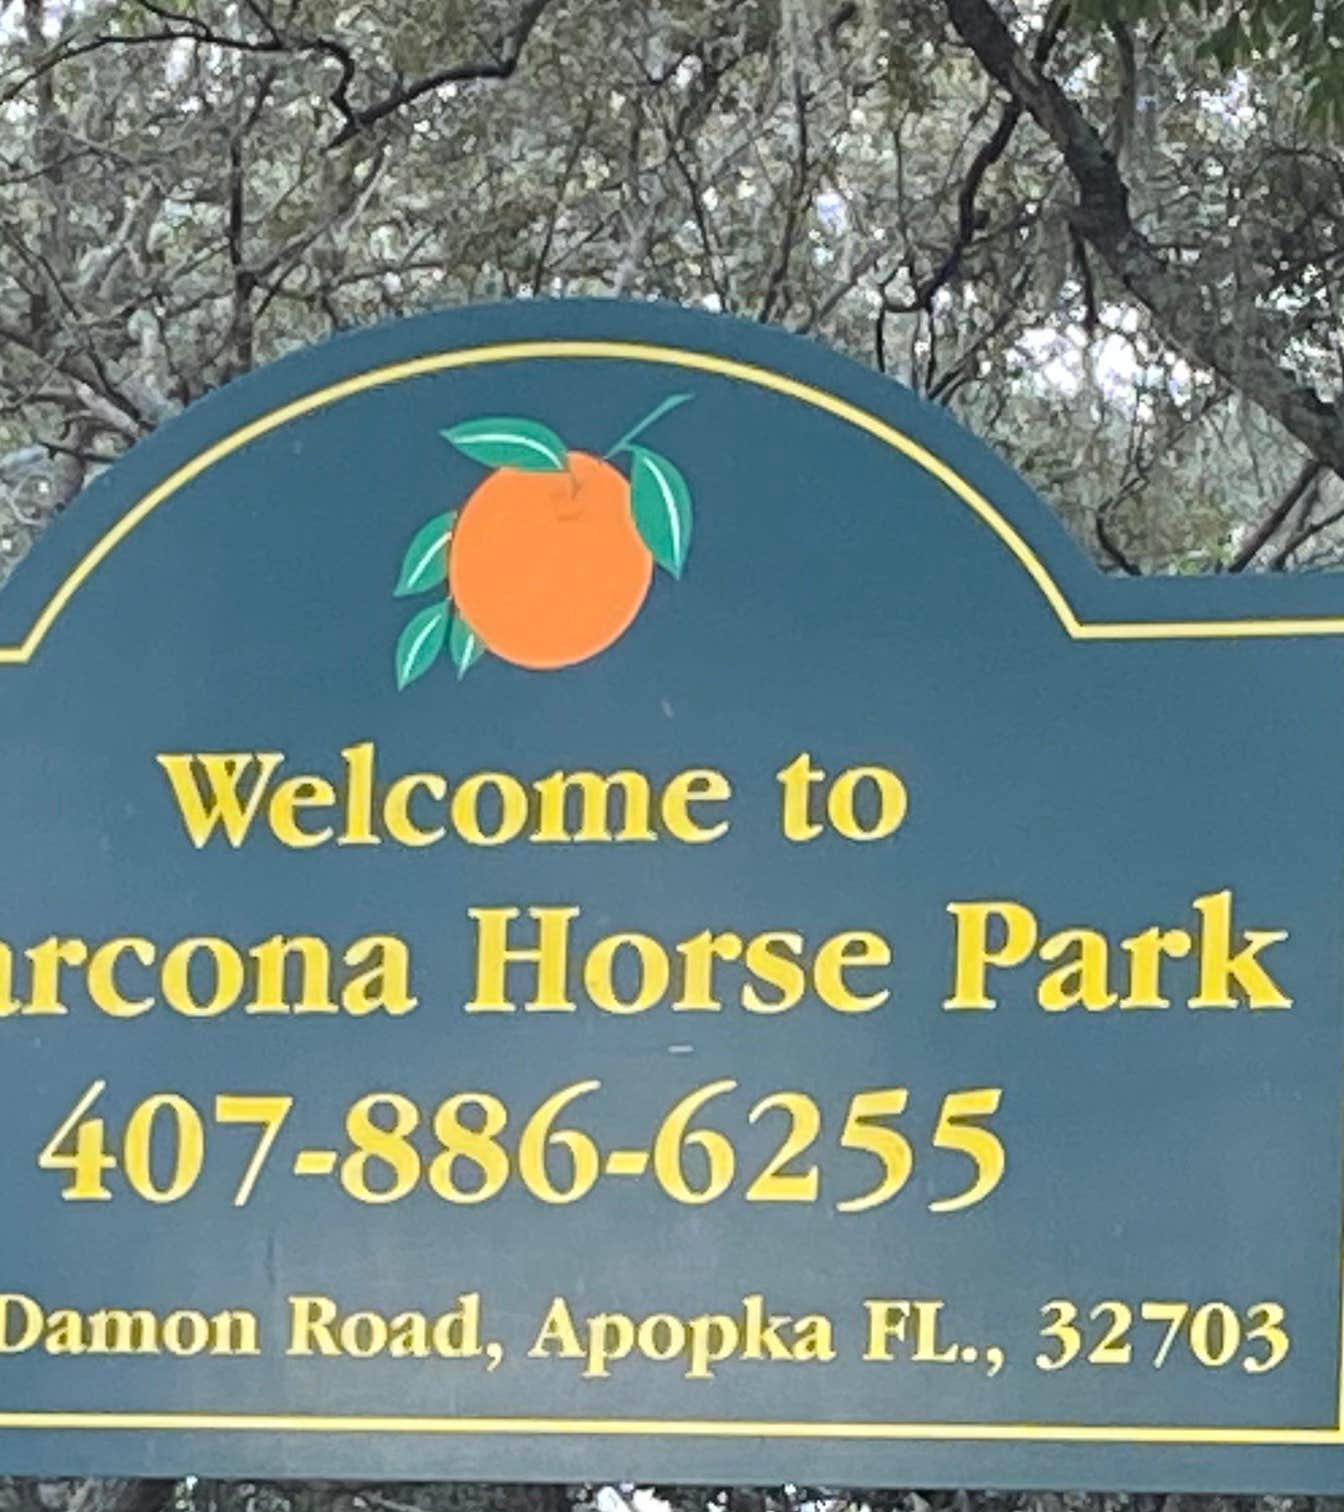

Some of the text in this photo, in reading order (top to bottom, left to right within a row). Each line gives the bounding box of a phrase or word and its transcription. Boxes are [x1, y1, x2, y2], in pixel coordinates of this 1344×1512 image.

[156, 741, 909, 848] Welcome to
[464, 904, 892, 1014] Horse
[942, 889, 1294, 1012] Park
[37, 1078, 1007, 1212] 407-886-6255
[286, 1292, 503, 1370] Road,
[527, 1294, 836, 1379] Apopka
[862, 1298, 1004, 1374] FL.,
[1035, 1300, 1291, 1374] 32703
